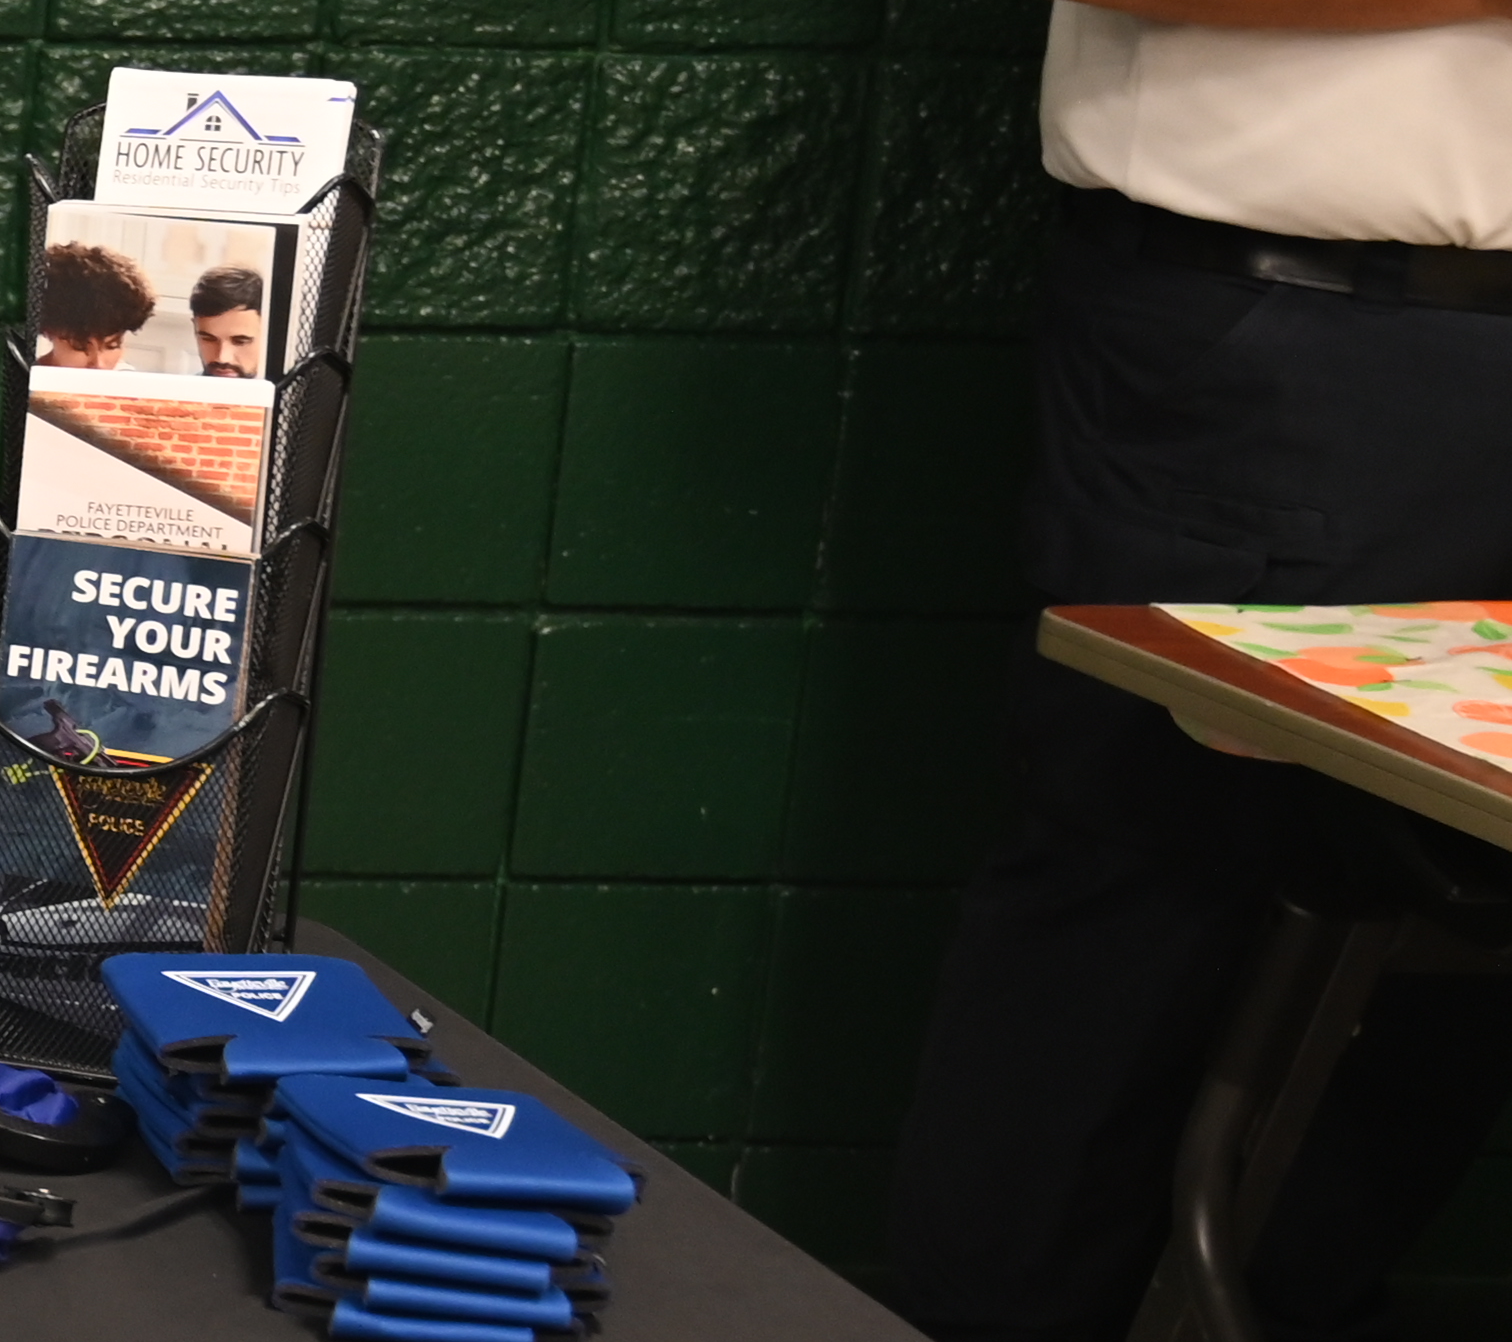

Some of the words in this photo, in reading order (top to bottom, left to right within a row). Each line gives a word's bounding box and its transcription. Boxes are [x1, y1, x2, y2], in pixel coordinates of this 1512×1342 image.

[115, 141, 186, 170] HOME
[194, 145, 305, 177] SECURITY
[113, 169, 195, 188] Residential
[200, 174, 264, 196] Security
[270, 178, 301, 197] Tips
[56, 514, 111, 531] POLICE
[116, 519, 224, 539] DEPARTMENT
[87, 501, 195, 522] FAYETTEVILLE
[71, 570, 239, 622] SECURE
[106, 615, 233, 665] YOUR
[6, 644, 229, 705] FIREARMS
